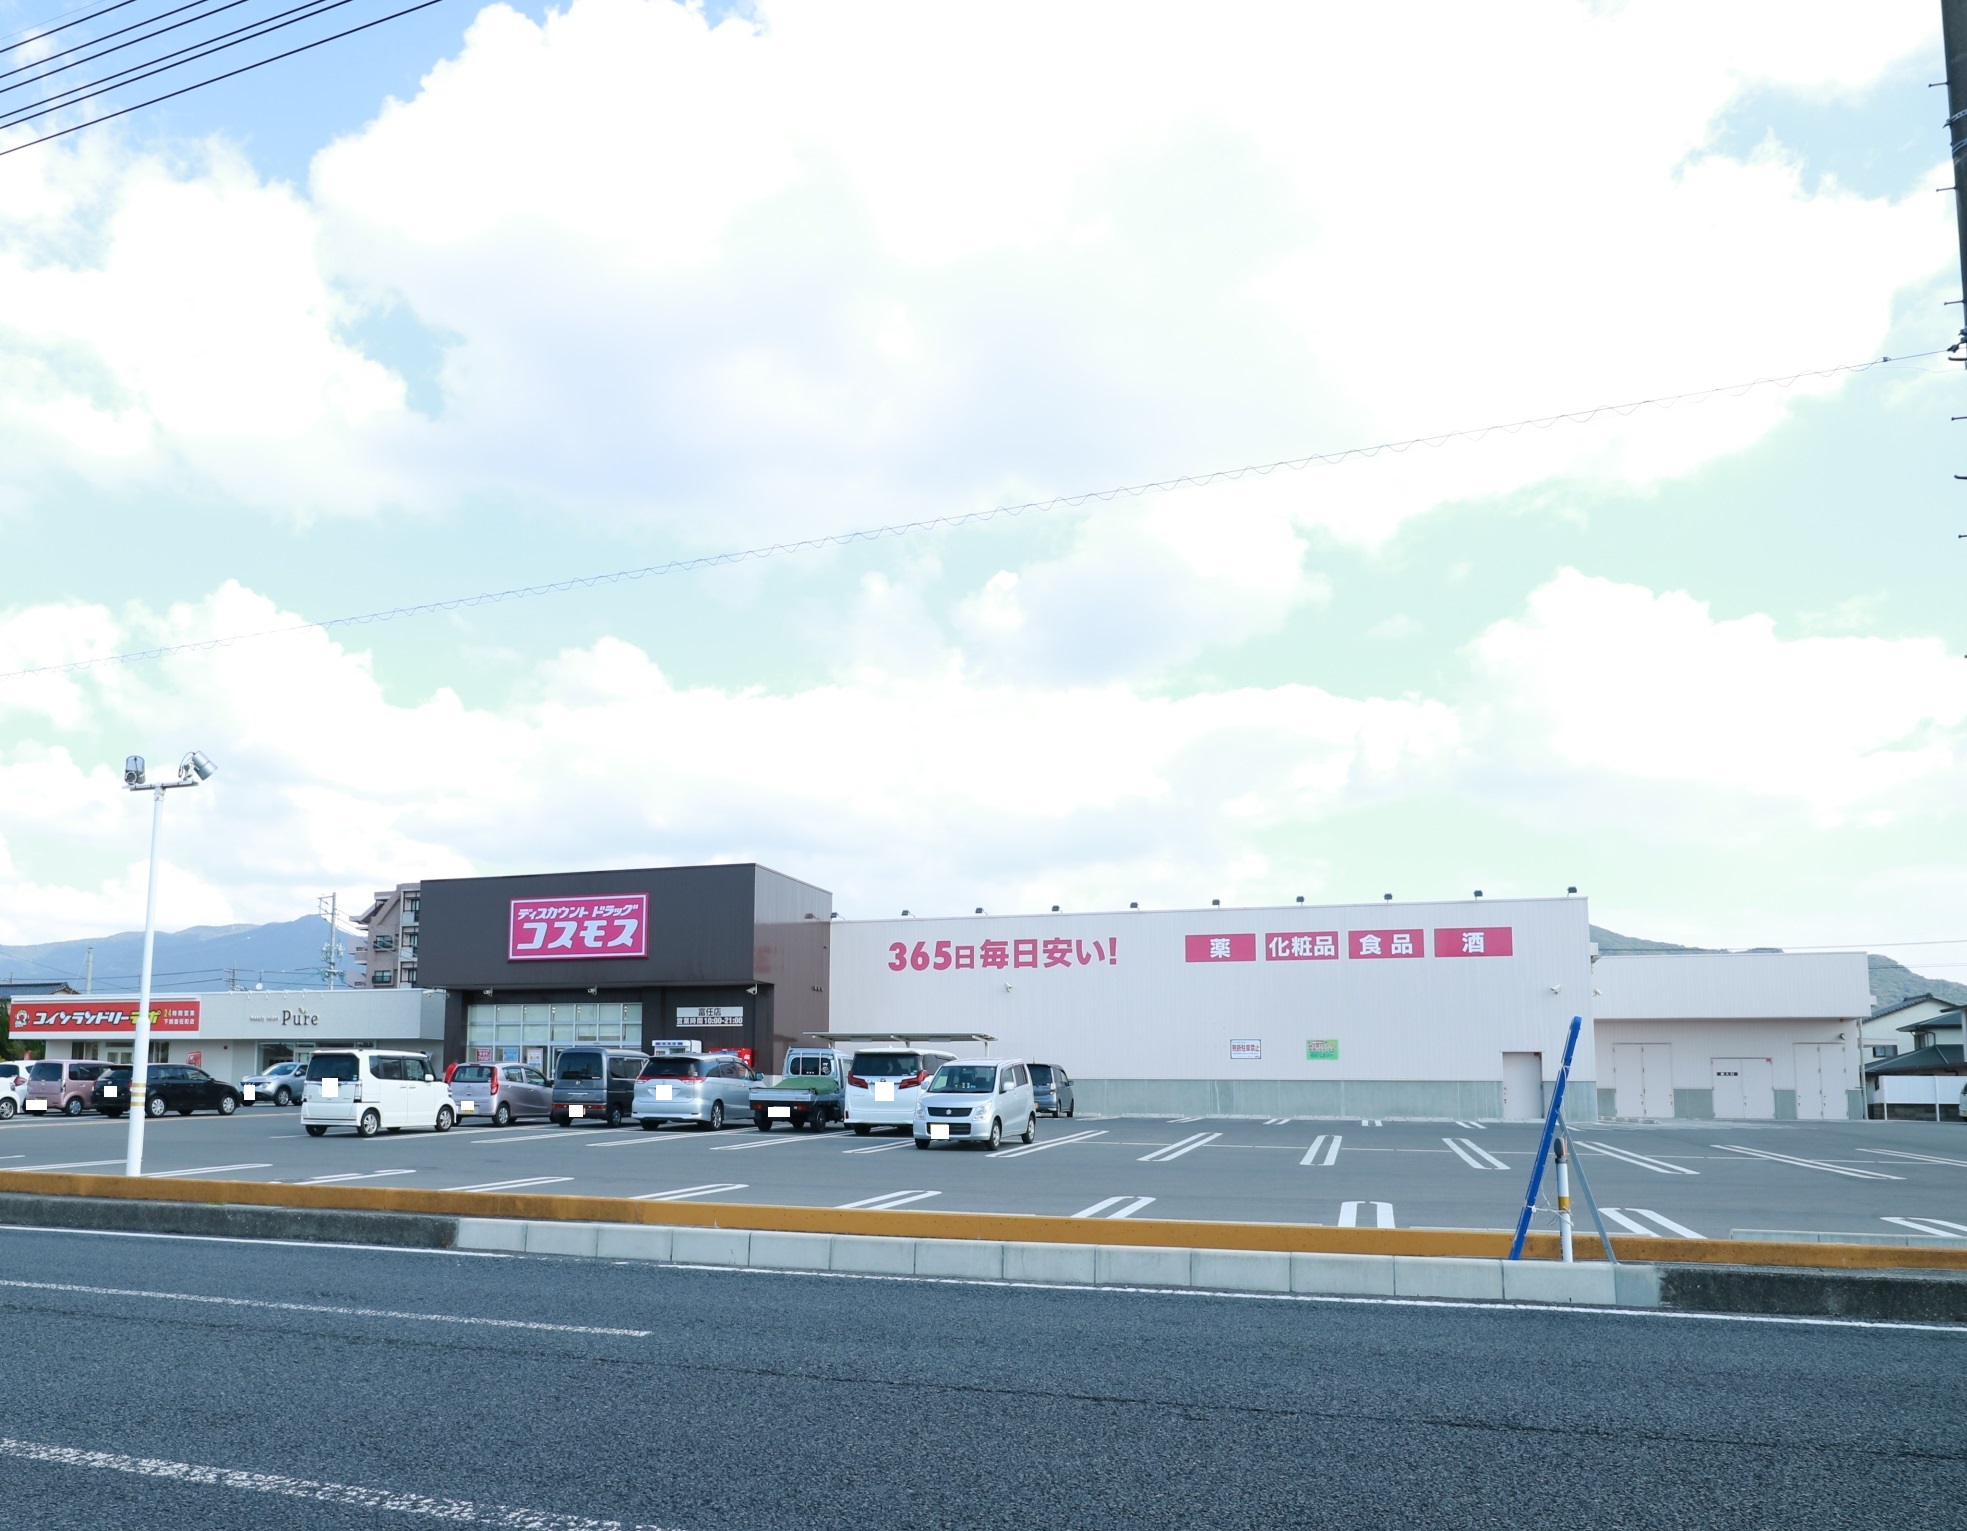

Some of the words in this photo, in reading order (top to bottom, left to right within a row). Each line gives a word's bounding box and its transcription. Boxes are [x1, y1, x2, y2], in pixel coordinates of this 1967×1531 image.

[517, 906, 589, 920] ディスカウント
[592, 904, 639, 918] ドラッグ
[516, 918, 639, 950] コスモス
[1462, 932, 1485, 953] 酒
[888, 937, 1117, 972] 365日毎日安い!
[1209, 938, 1231, 959] 薬
[1268, 936, 1336, 958] 化粧品
[1359, 934, 1413, 956] 食品
[281, 1009, 319, 1026] Pure
[697, 1008, 722, 1017] 富任店
